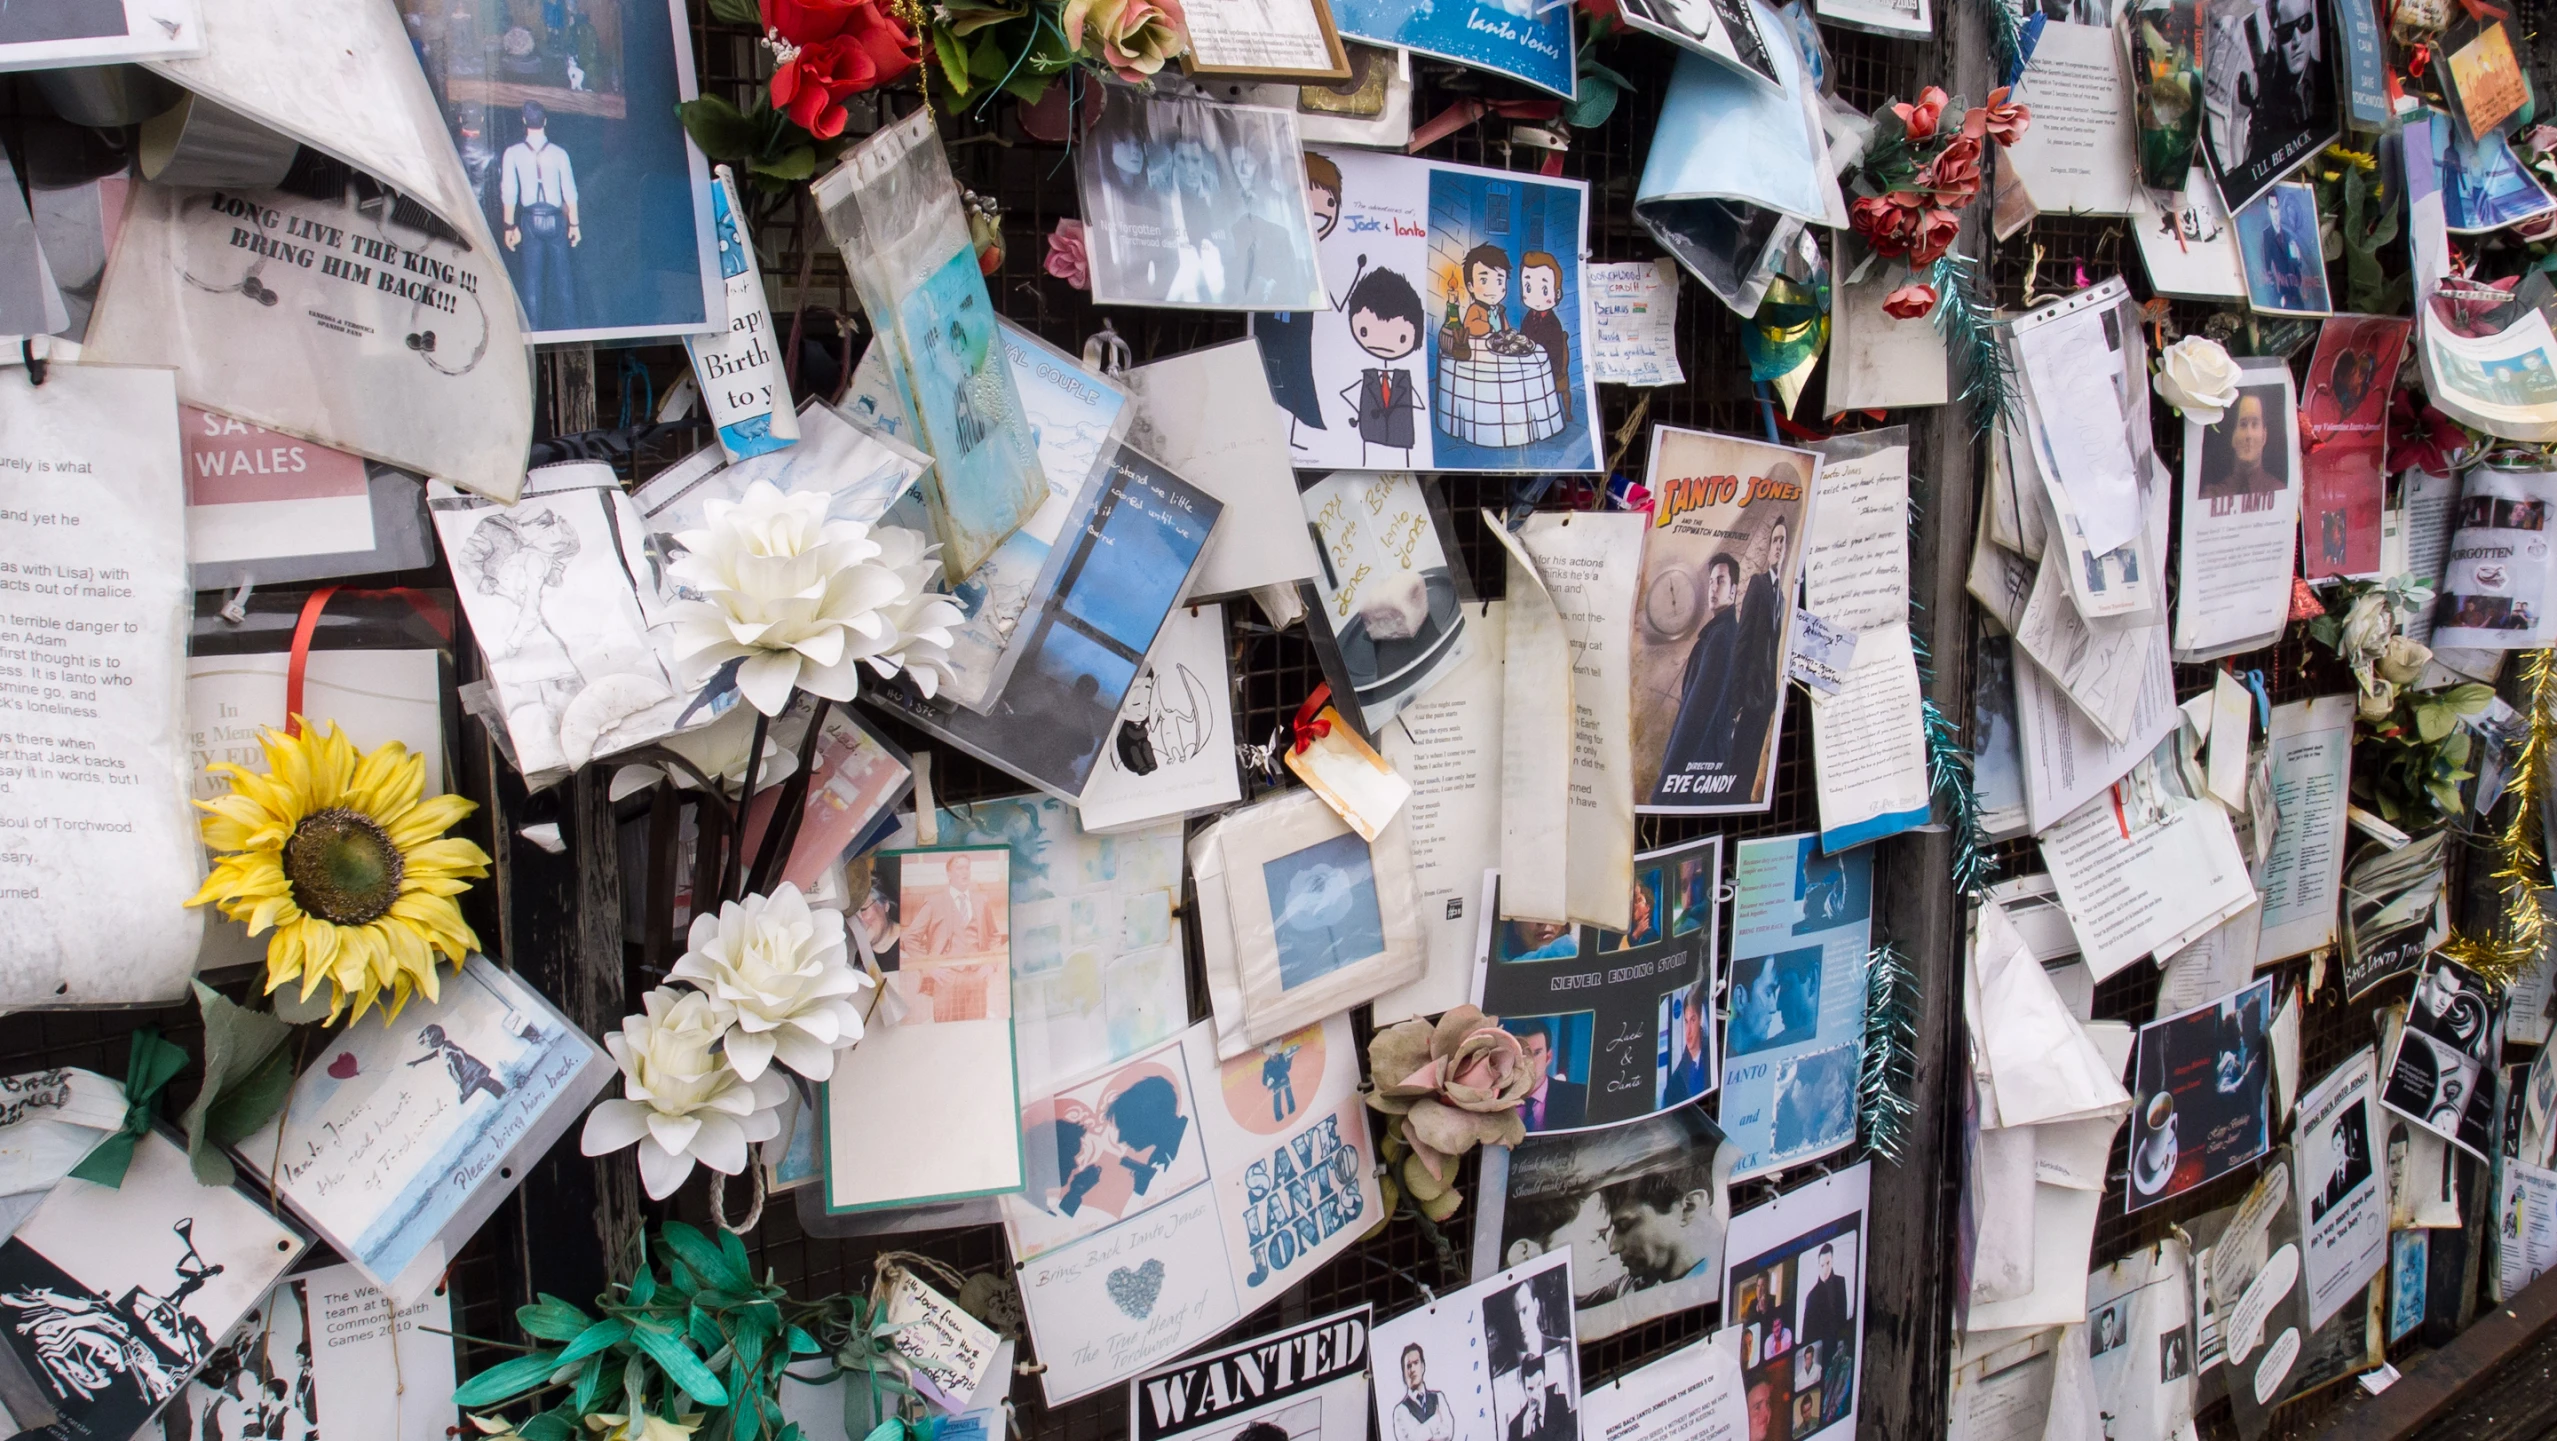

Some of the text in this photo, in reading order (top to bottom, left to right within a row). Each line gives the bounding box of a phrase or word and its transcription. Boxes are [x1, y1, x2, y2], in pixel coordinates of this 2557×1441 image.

[1466, 7, 1560, 60] Ianto Jones
[2271, 149, 2286, 167] BE
[2286, 129, 2312, 156] BACK
[211, 191, 280, 230] LONG
[286, 215, 344, 249] LIVE
[350, 233, 398, 265] THE
[403, 251, 455, 284] KING
[1393, 216, 1426, 237] Ianto
[229, 227, 457, 314] BRING HIM BACK!!!
[1036, 362, 1100, 406] COUPLE
[727, 390, 755, 409] to
[195, 447, 307, 477] WALES
[1656, 475, 1803, 529] IANTO JONES
[2241, 491, 2275, 514] IANTO
[0, 509, 80, 526] and yet he
[1672, 524, 1750, 541] STOPWATCH ADVENTURES
[0, 562, 130, 582] as with Lisa} with
[1538, 554, 1605, 569] for his actions
[1570, 571, 1599, 581] he's a
[0, 580, 136, 598] acts out of malice.
[1564, 584, 1582, 594] and
[10, 614, 138, 635] terrible danger to
[1572, 613, 1585, 622] not
[1589, 641, 1603, 651] cat
[27, 700, 101, 719] loneliness.
[219, 702, 238, 718] In
[16, 733, 95, 750] there when
[1581, 758, 1606, 771] did the
[1685, 762, 1724, 773] DIRECTED BY
[1661, 774, 1737, 794] EYE CANDY
[1576, 796, 1597, 808] have
[34, 817, 49, 829] of
[52, 818, 136, 833] Torchwood.
[1551, 950, 1688, 991] NEVER ENDING STORY
[2367, 951, 2398, 975] IANTO
[1606, 1021, 1644, 1052] Jack
[1620, 1046, 1634, 1066] &
[1607, 1069, 1643, 1093] Ianto
[1727, 1063, 1768, 1086] IANTO
[2303, 1114, 2320, 1133] BRING
[2320, 1103, 2334, 1120] BACK
[2350, 1072, 2369, 1094] JONES
[453, 1056, 580, 1190] Please bring him back.
[1739, 1108, 1760, 1126] and
[1245, 1113, 1342, 1206] SAVE
[1243, 1144, 1359, 1248] IANTO
[1247, 1178, 1364, 1287] JONES
[1036, 1264, 1082, 1288] Bring
[1085, 1236, 1121, 1268] Back
[1129, 1222, 1164, 1250] Ianto
[324, 1292, 350, 1305] The
[325, 1300, 377, 1320] team at
[327, 1302, 429, 1334] Commonwealth
[1072, 1288, 1210, 1367] The True Heart of
[328, 1320, 411, 1348] Games 2010
[1112, 1320, 1182, 1370] Torchwood
[1147, 1319, 1365, 1429] WANTED
[1606, 1423, 1622, 1435] BRING
[1623, 1416, 1636, 1427] BACK
[1636, 1408, 1652, 1420] IANTO
[1652, 1400, 1667, 1412] JONES
[1678, 1389, 1687, 1398] THE
